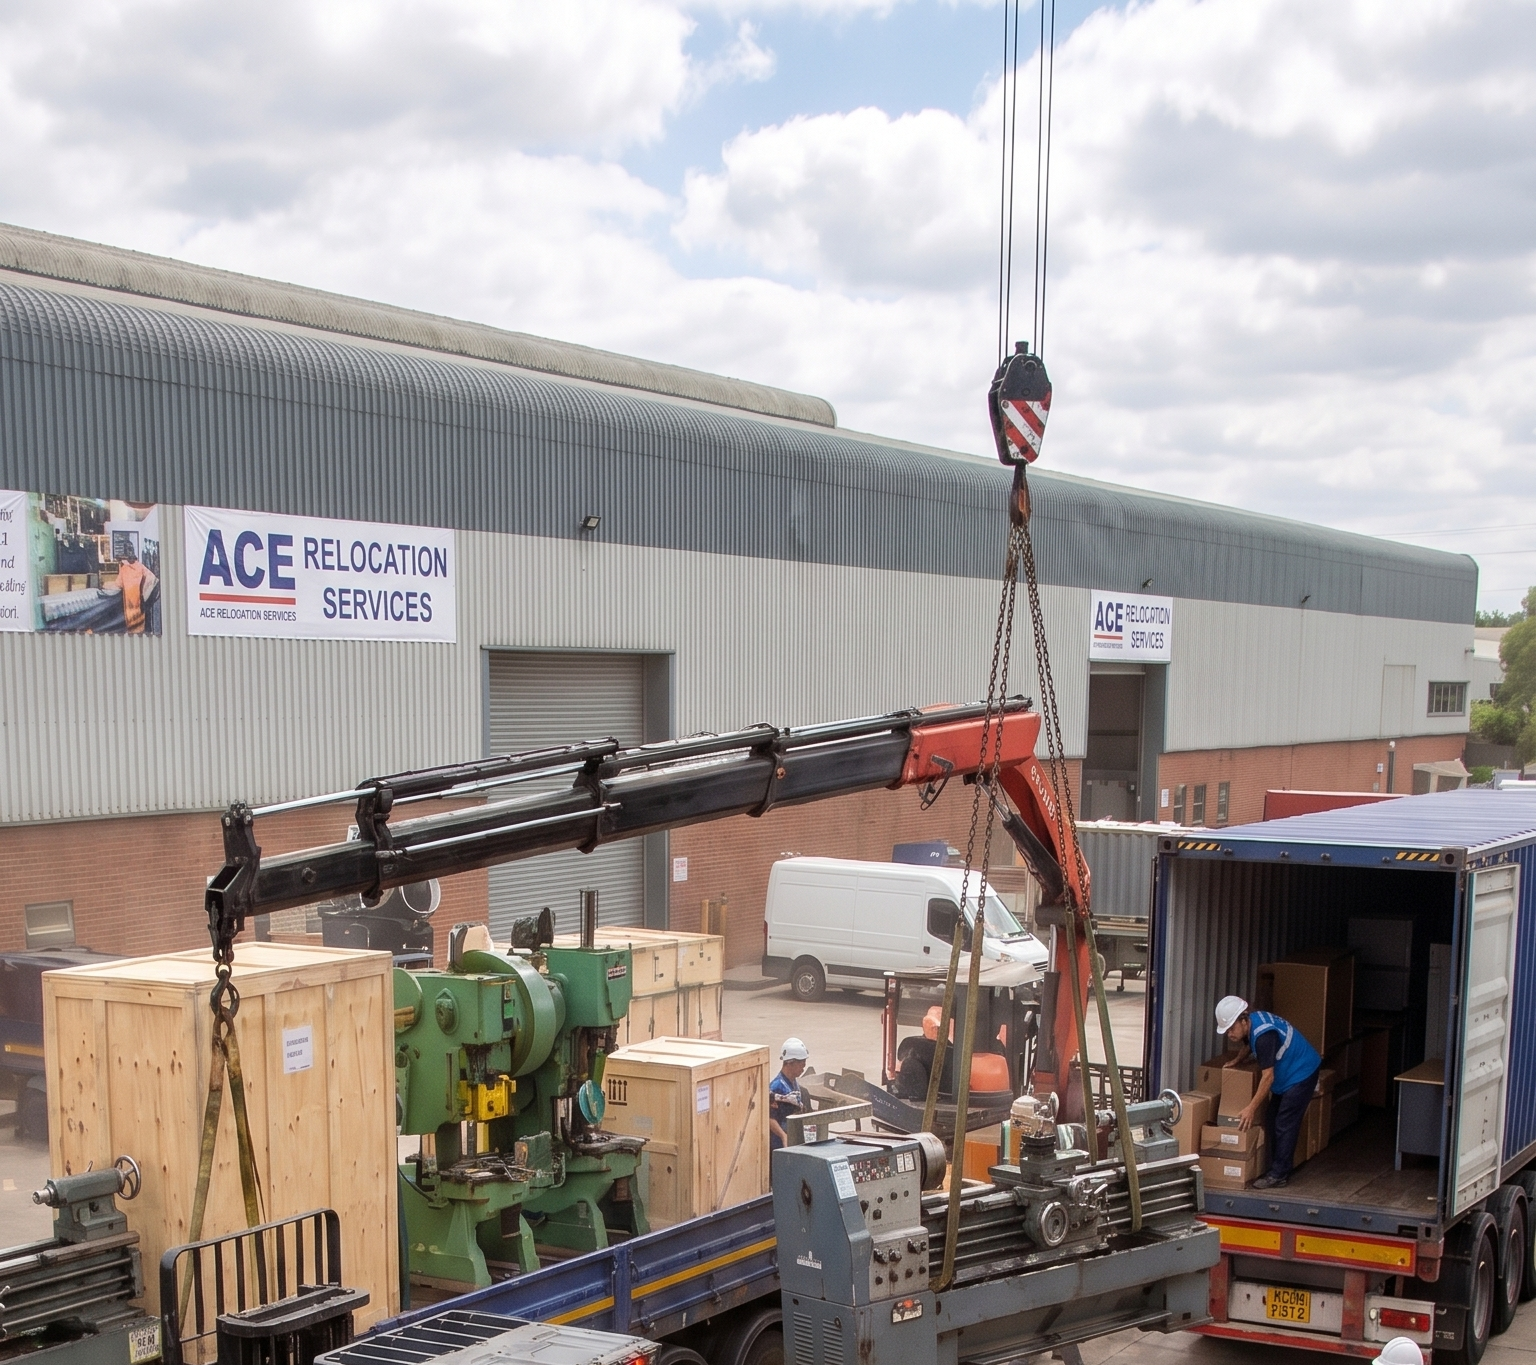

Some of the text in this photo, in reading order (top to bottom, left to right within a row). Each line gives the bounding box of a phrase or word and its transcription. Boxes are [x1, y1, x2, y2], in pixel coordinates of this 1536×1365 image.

[199, 528, 448, 591] ACE RELOCATION
[199, 607, 216, 619] ACE
[262, 610, 297, 622] SERVICES
[322, 586, 433, 623] SERVICES
[1094, 600, 1171, 633] ACE RELOCATION
[1130, 630, 1164, 650] SERVICES
